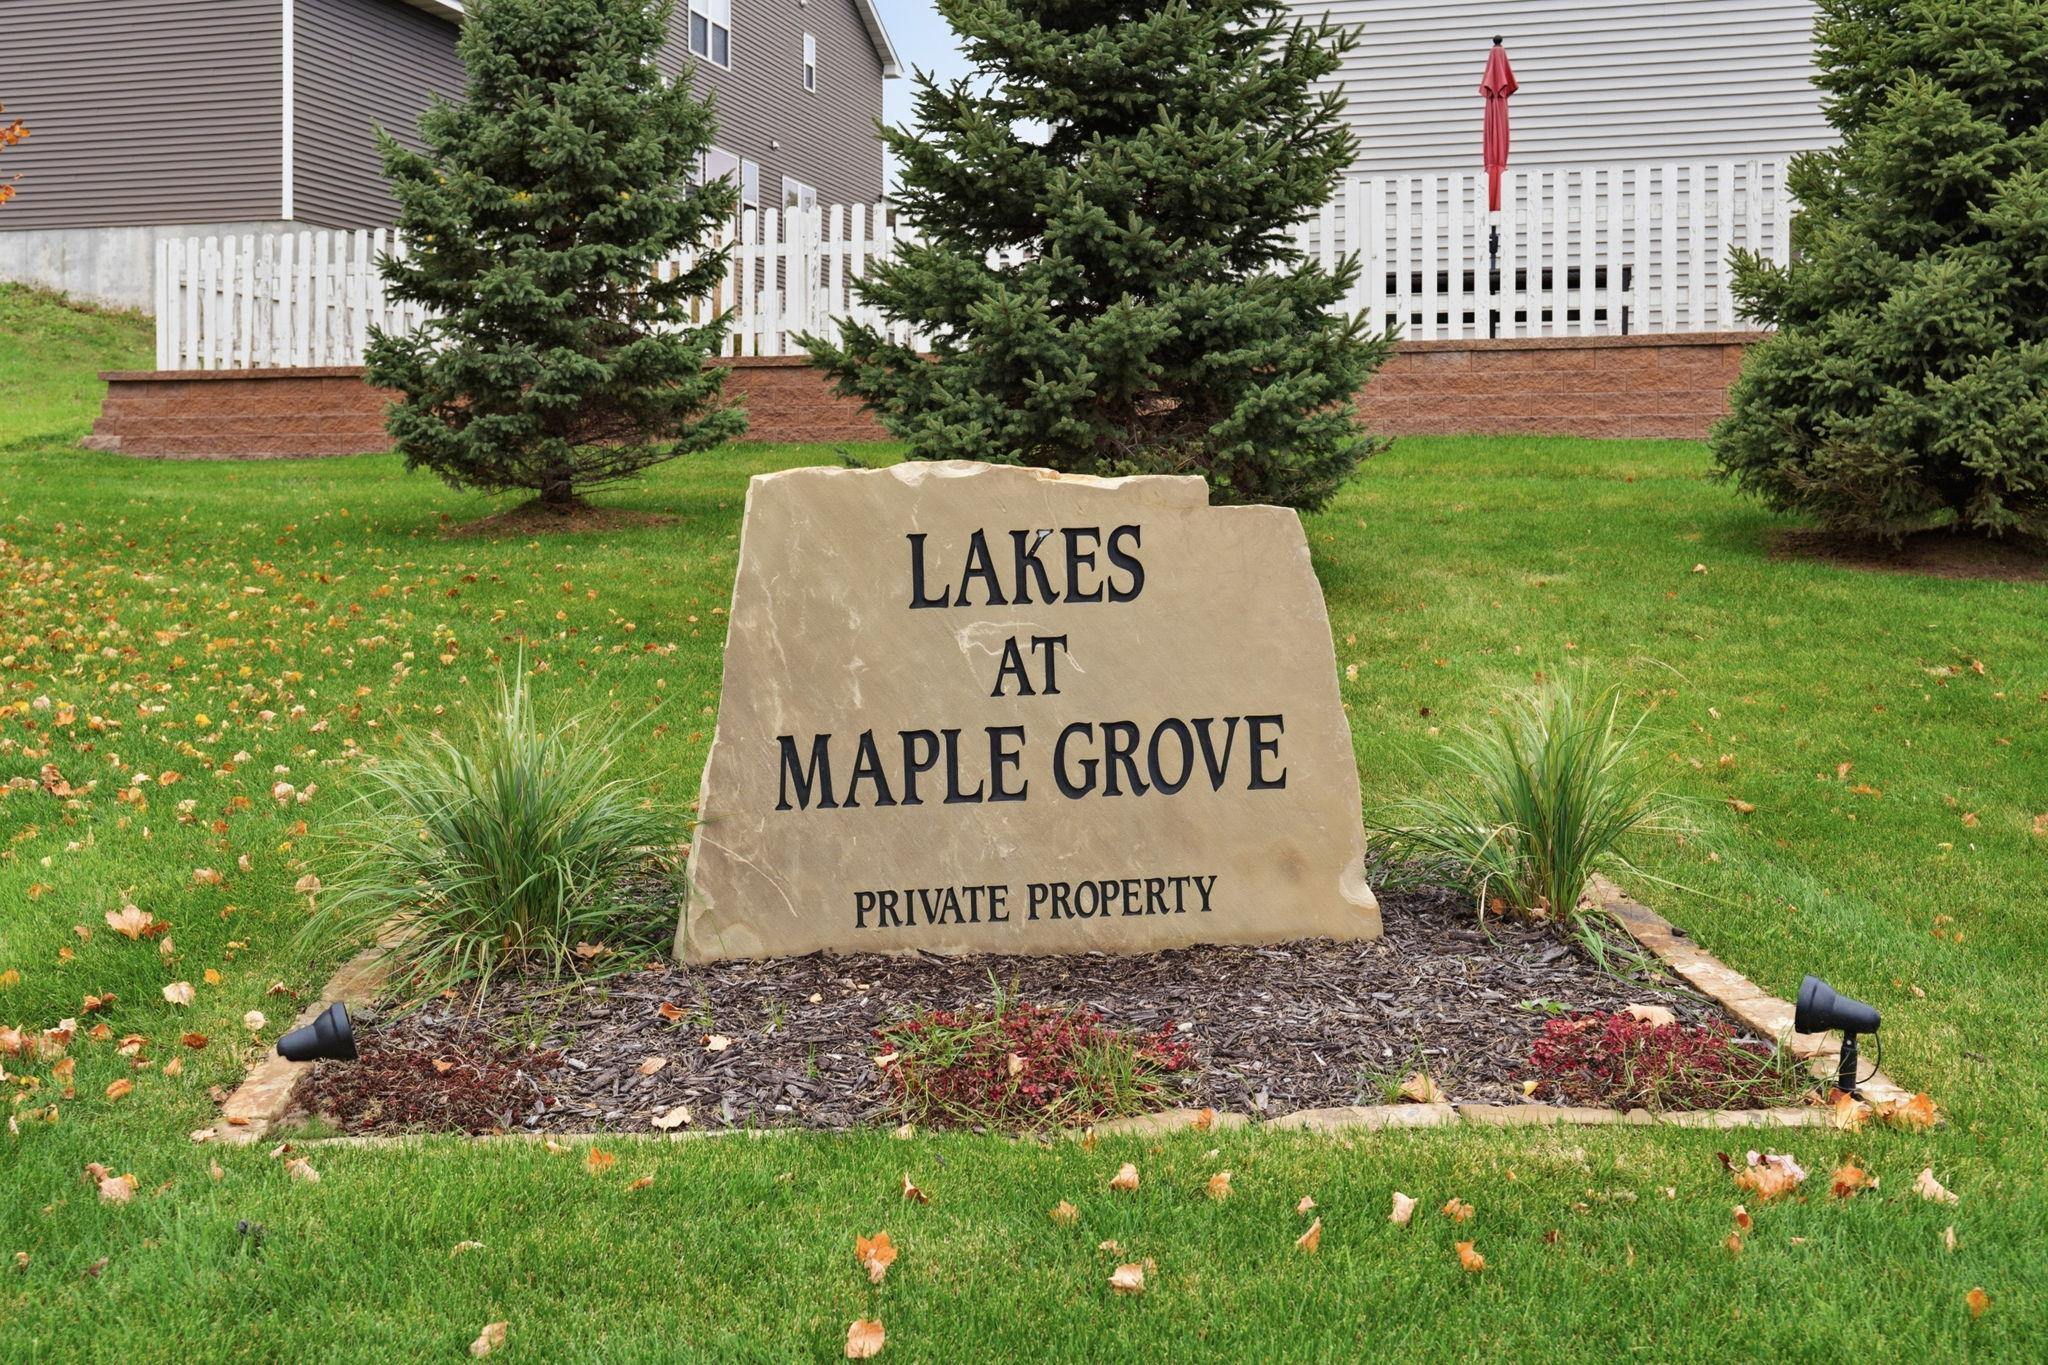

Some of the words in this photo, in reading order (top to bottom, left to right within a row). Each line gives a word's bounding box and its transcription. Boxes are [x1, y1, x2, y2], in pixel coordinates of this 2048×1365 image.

[906, 524, 1145, 610] LAKES
[990, 634, 1068, 698] AT
[775, 724, 1029, 811] MAPLE
[1053, 713, 1288, 800] GROVE
[854, 884, 1010, 929] PRIVATE
[1027, 874, 1218, 921] PROPERTY
